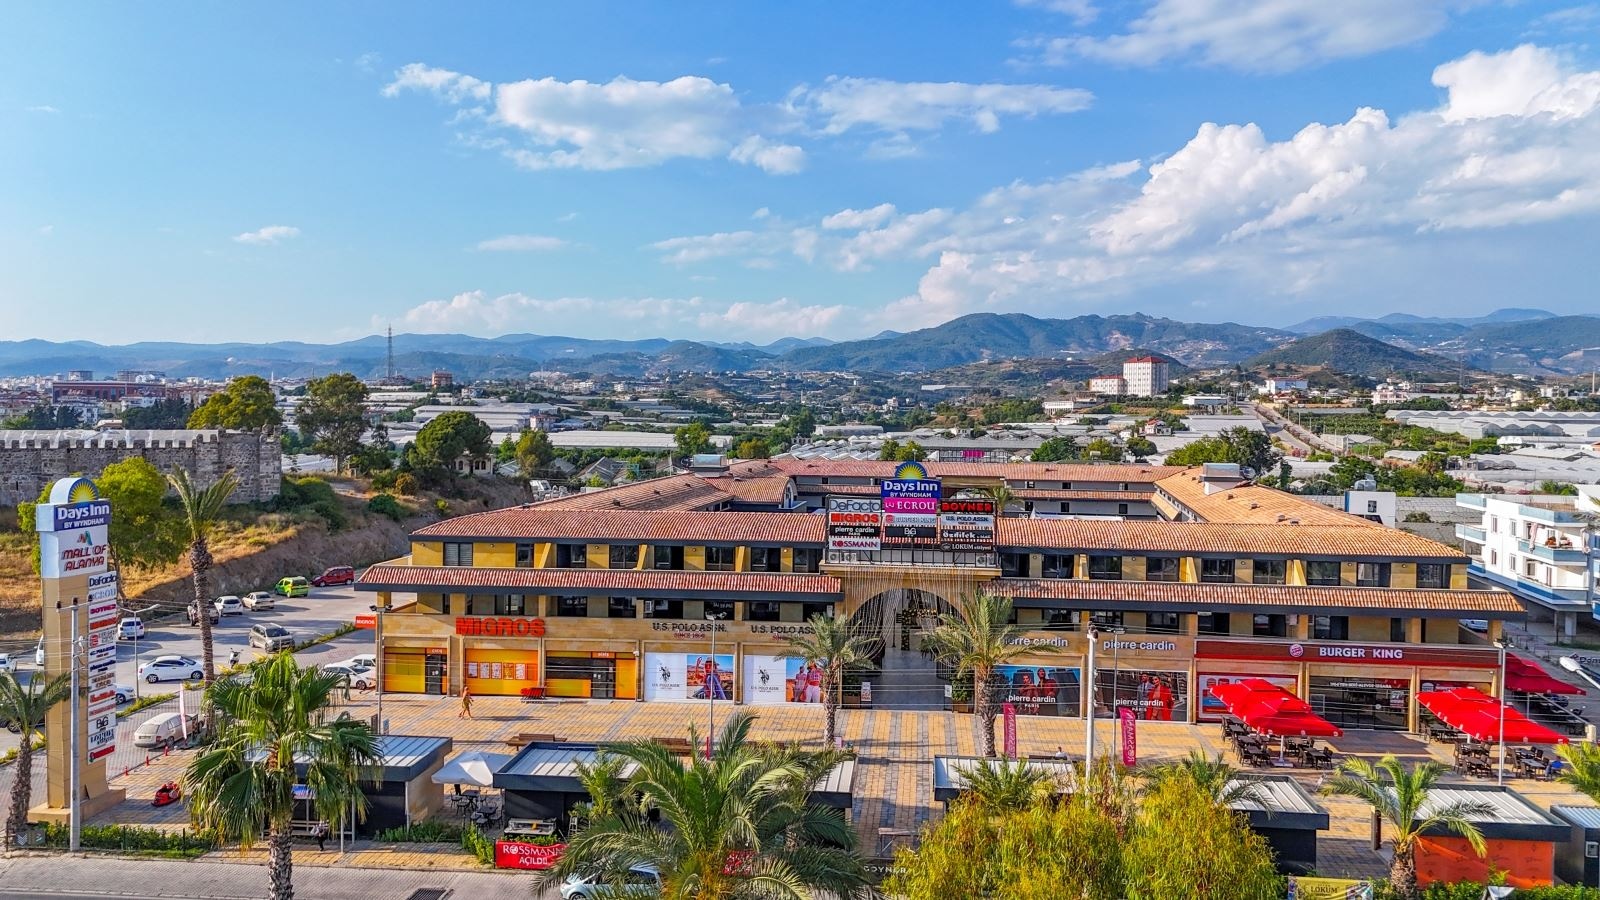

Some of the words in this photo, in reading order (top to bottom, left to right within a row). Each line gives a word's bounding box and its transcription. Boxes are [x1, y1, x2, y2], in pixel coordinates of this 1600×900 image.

[884, 481, 915, 491] Days
[916, 481, 938, 491] Inn
[829, 500, 880, 510] DeFacto
[897, 501, 935, 510] ECROU
[942, 503, 992, 511] BOYNER
[57, 507, 89, 520] Days
[90, 504, 110, 516] Inn
[74, 518, 105, 528] WYNDHAM
[63, 547, 91, 560] MALL
[93, 545, 107, 554] OF
[64, 556, 105, 571] ALANYA
[652, 622, 670, 631] U.S.
[671, 623, 698, 632] POLO
[750, 625, 768, 634] U.S.
[769, 625, 796, 634] POLO
[1032, 636, 1069, 647] cardin
[1103, 640, 1137, 651] pierre
[1139, 640, 1177, 651] cardin
[1319, 647, 1366, 657] BURGER
[1372, 649, 1403, 659] KING
[1008, 694, 1031, 702] pierre
[1115, 697, 1138, 706] pierre
[1139, 699, 1164, 707] cardin
[1310, 886, 1338, 894] LOKUM
